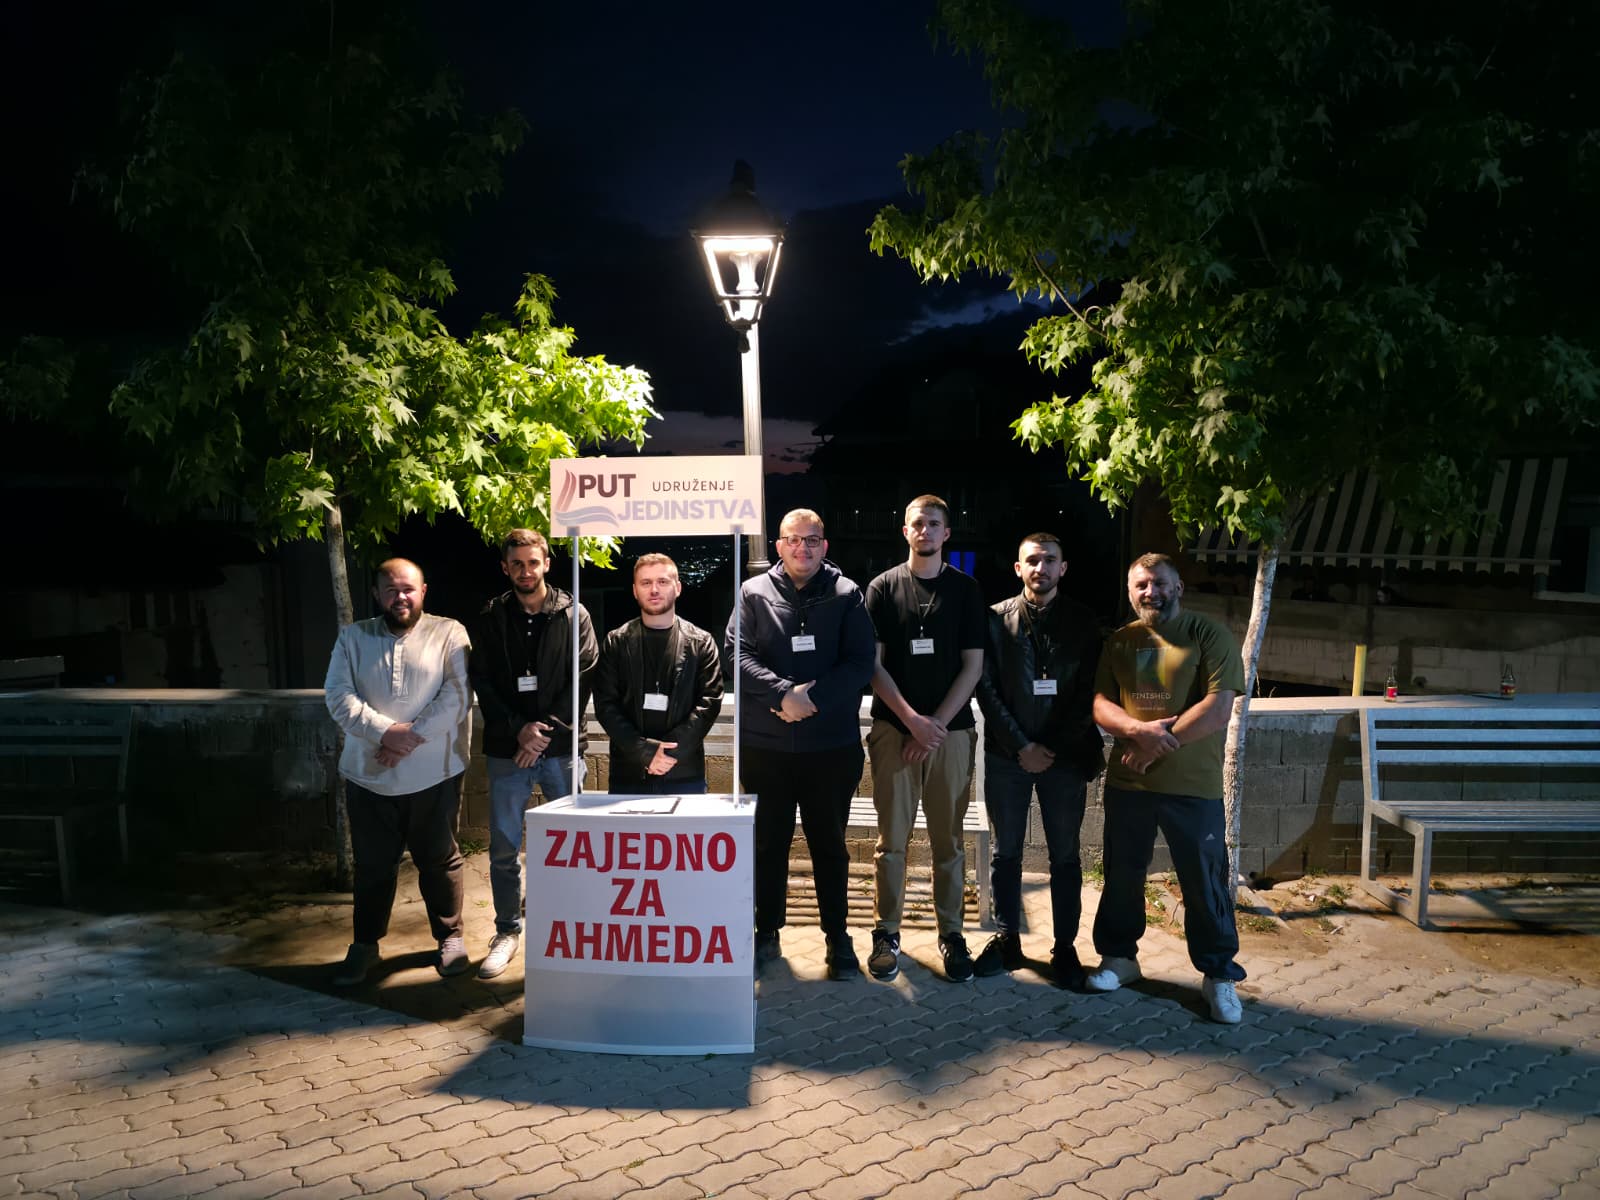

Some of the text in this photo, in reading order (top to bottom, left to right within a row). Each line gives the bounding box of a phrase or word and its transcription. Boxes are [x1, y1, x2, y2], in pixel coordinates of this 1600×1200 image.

[578, 473, 637, 498] PUT
[652, 478, 735, 492] UDRUŽENJE
[617, 498, 757, 521] JEDINSTVA
[1131, 692, 1171, 700] FINISHED
[544, 829, 737, 873] ZAJEDNO
[609, 877, 666, 917] ZA
[544, 920, 734, 964] AHMEDA
